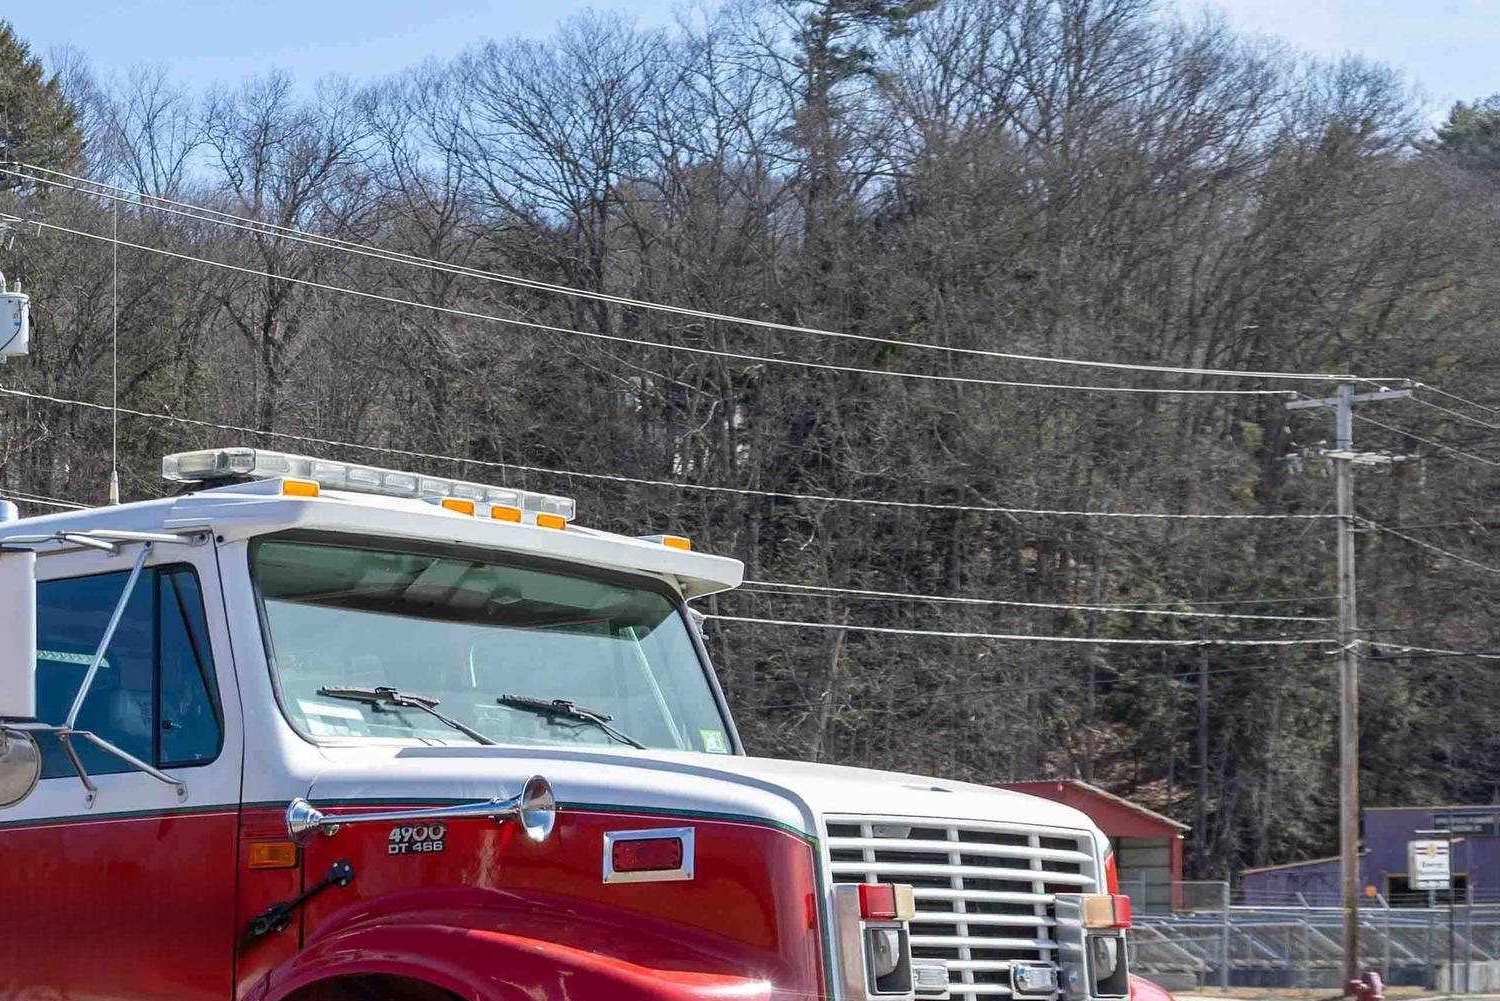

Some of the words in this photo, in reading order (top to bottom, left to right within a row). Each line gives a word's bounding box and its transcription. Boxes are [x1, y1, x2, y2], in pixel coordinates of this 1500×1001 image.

[388, 824, 446, 842] 4900
[388, 842, 409, 854] DT
[412, 841, 443, 852] 466
